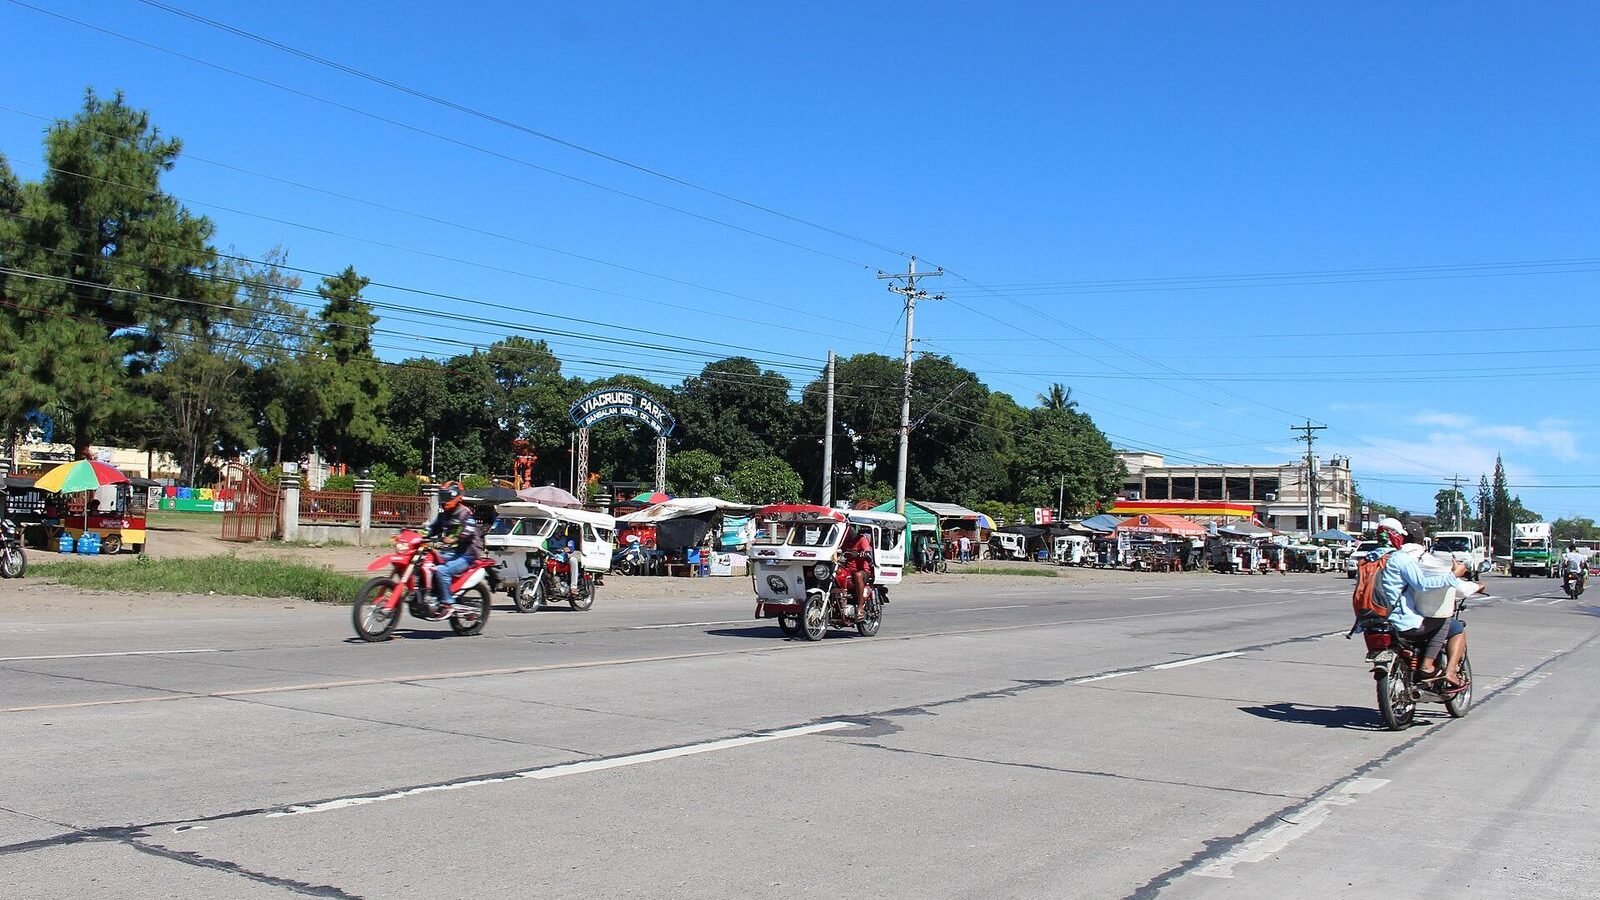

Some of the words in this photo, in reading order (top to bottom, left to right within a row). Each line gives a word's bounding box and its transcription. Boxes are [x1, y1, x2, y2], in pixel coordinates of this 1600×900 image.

[580, 392, 633, 414] VIACRUCIS
[640, 398, 665, 423] PARK
[586, 407, 618, 425] BANSALAN
